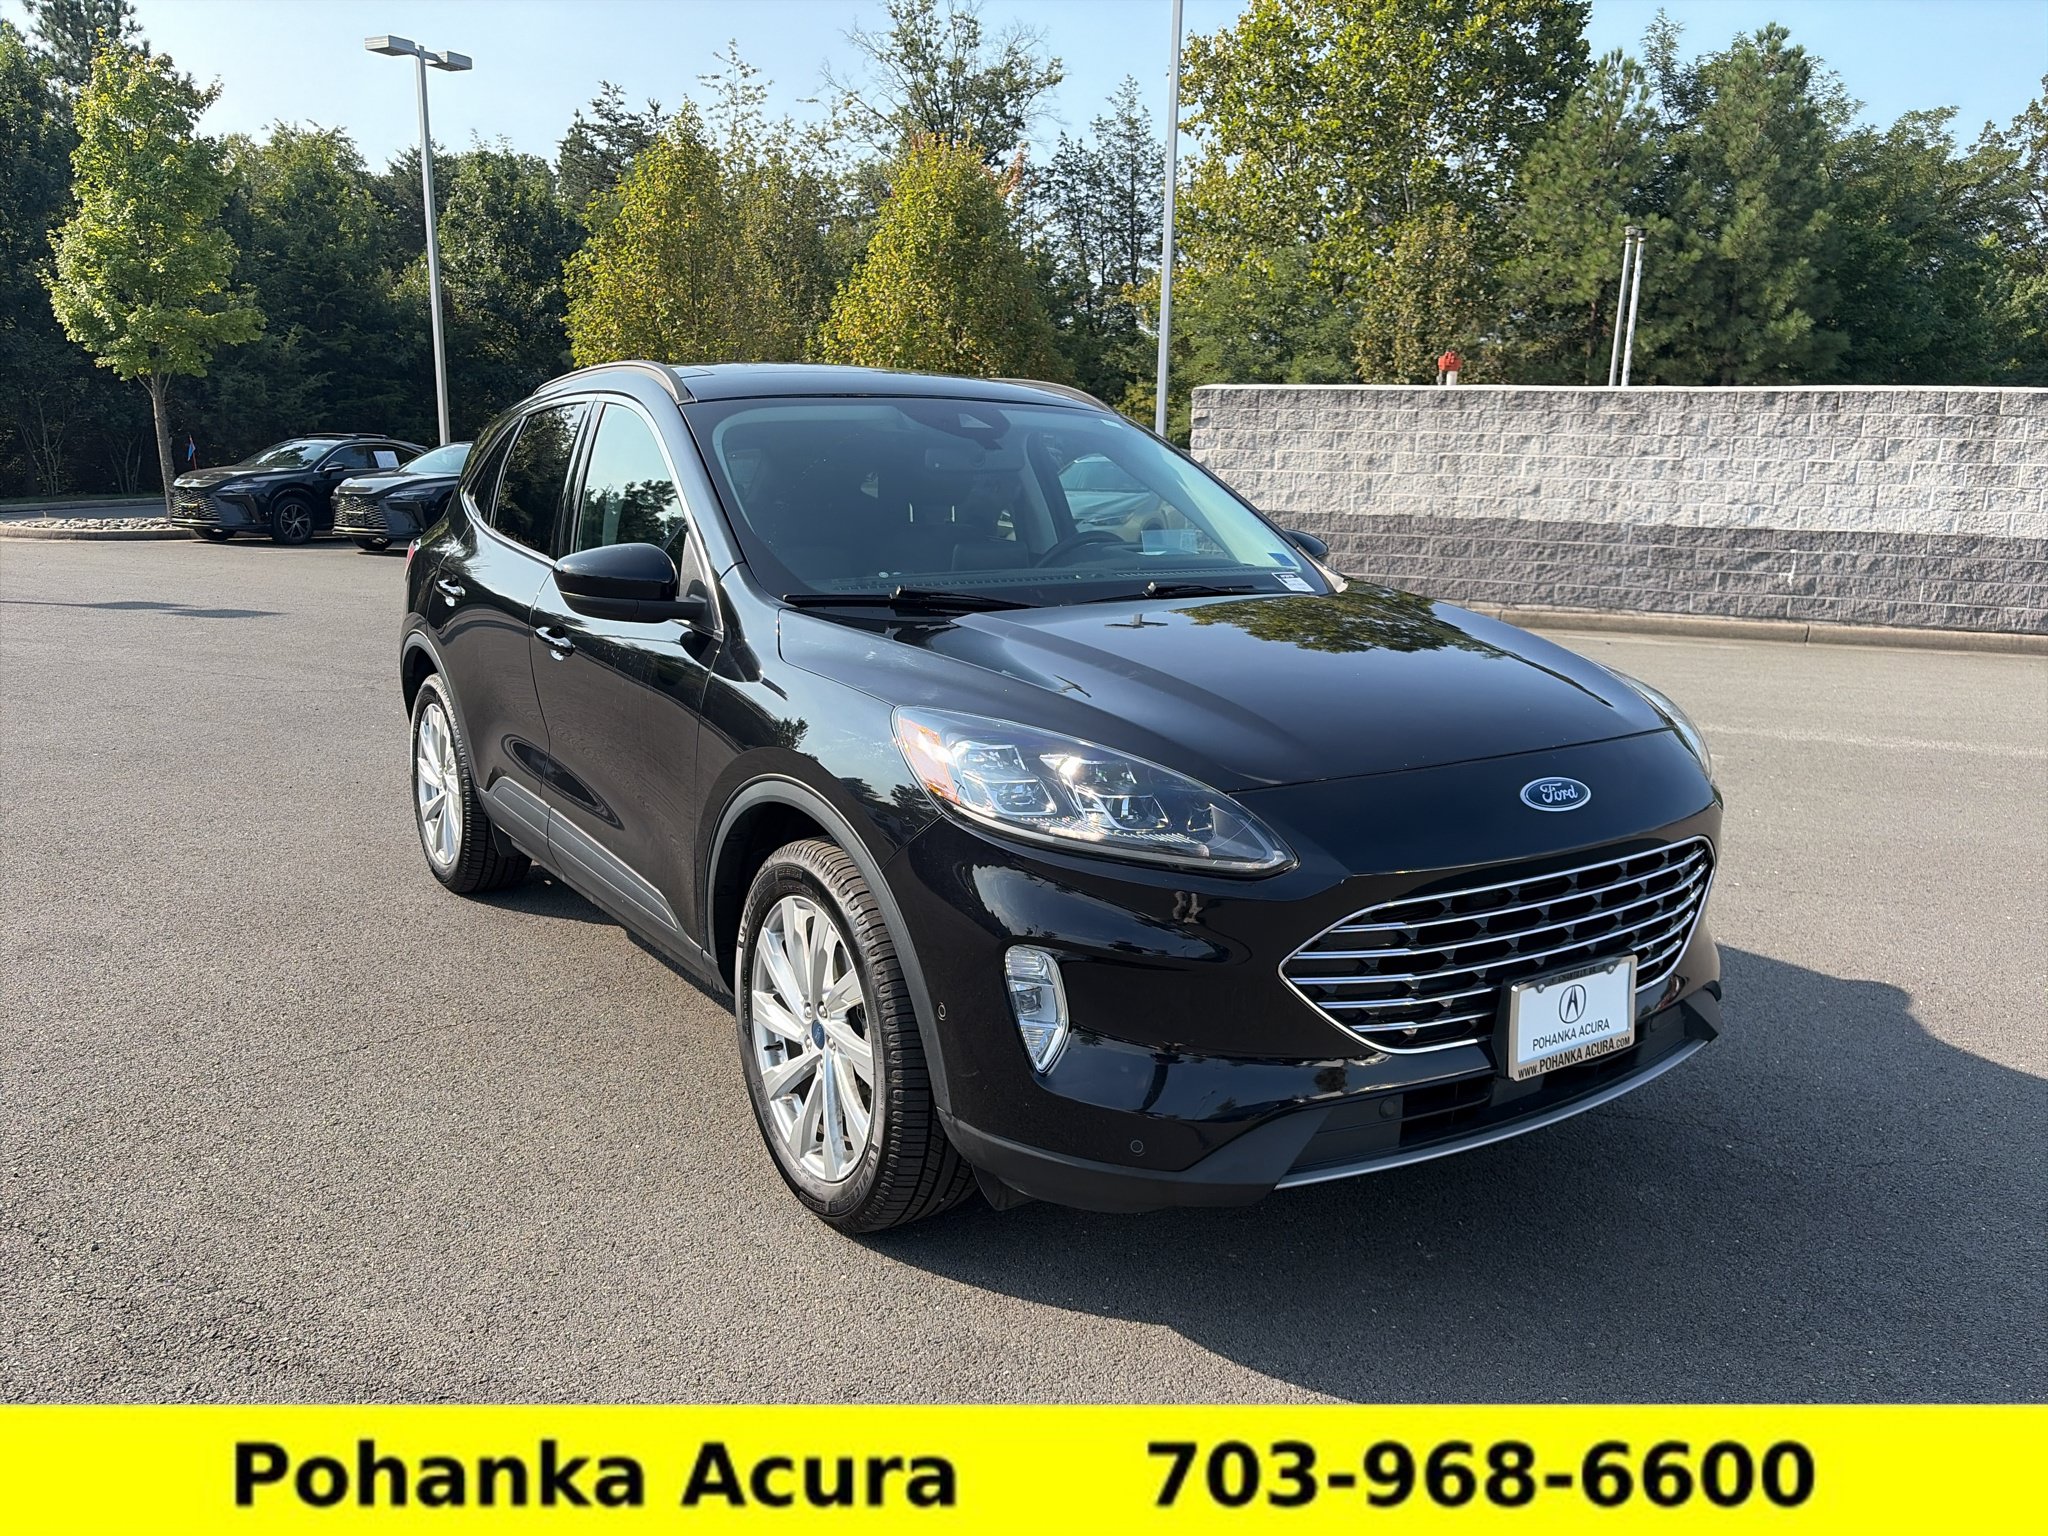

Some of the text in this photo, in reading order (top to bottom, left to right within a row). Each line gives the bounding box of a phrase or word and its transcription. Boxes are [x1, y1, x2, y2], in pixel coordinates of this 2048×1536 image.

[1540, 783, 1578, 803] Ford
[1532, 1018, 1610, 1051] POHANKA ACURA
